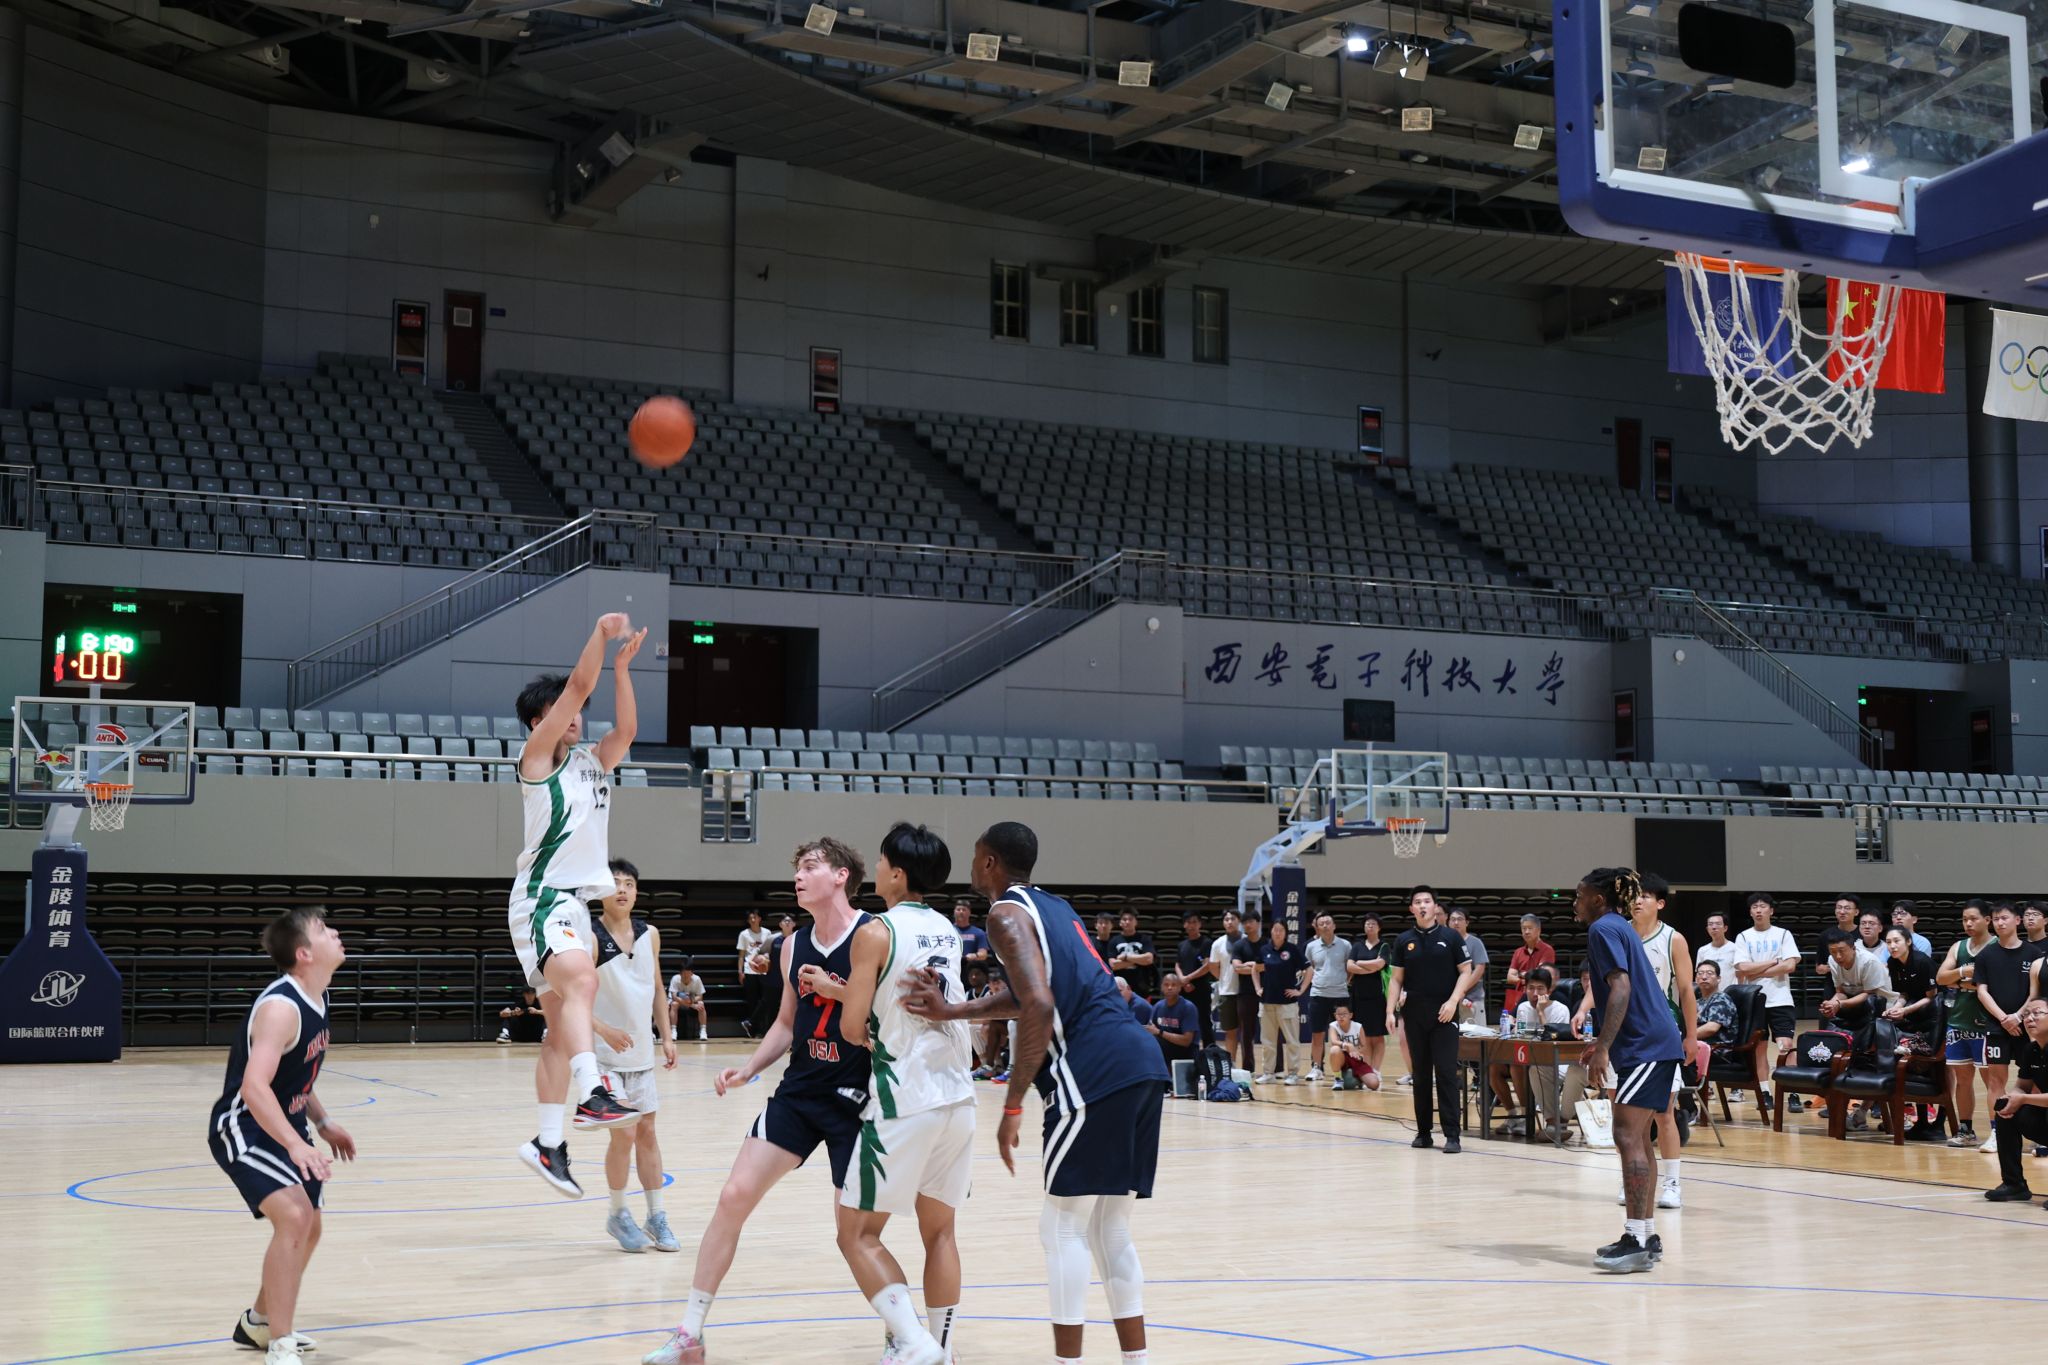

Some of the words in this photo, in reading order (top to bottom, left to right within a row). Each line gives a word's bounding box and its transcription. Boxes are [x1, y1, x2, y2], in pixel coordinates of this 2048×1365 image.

[96, 734, 115, 742] ANTA
[593, 787, 609, 809] 12
[48, 866, 73, 948] 金陵体育
[813, 994, 836, 1038] 7
[9, 1026, 104, 1039] 国际篮联合作伙伴
[807, 1039, 840, 1062] USA
[1517, 1045, 1525, 1063] 6
[1987, 1047, 2001, 1058] 30
